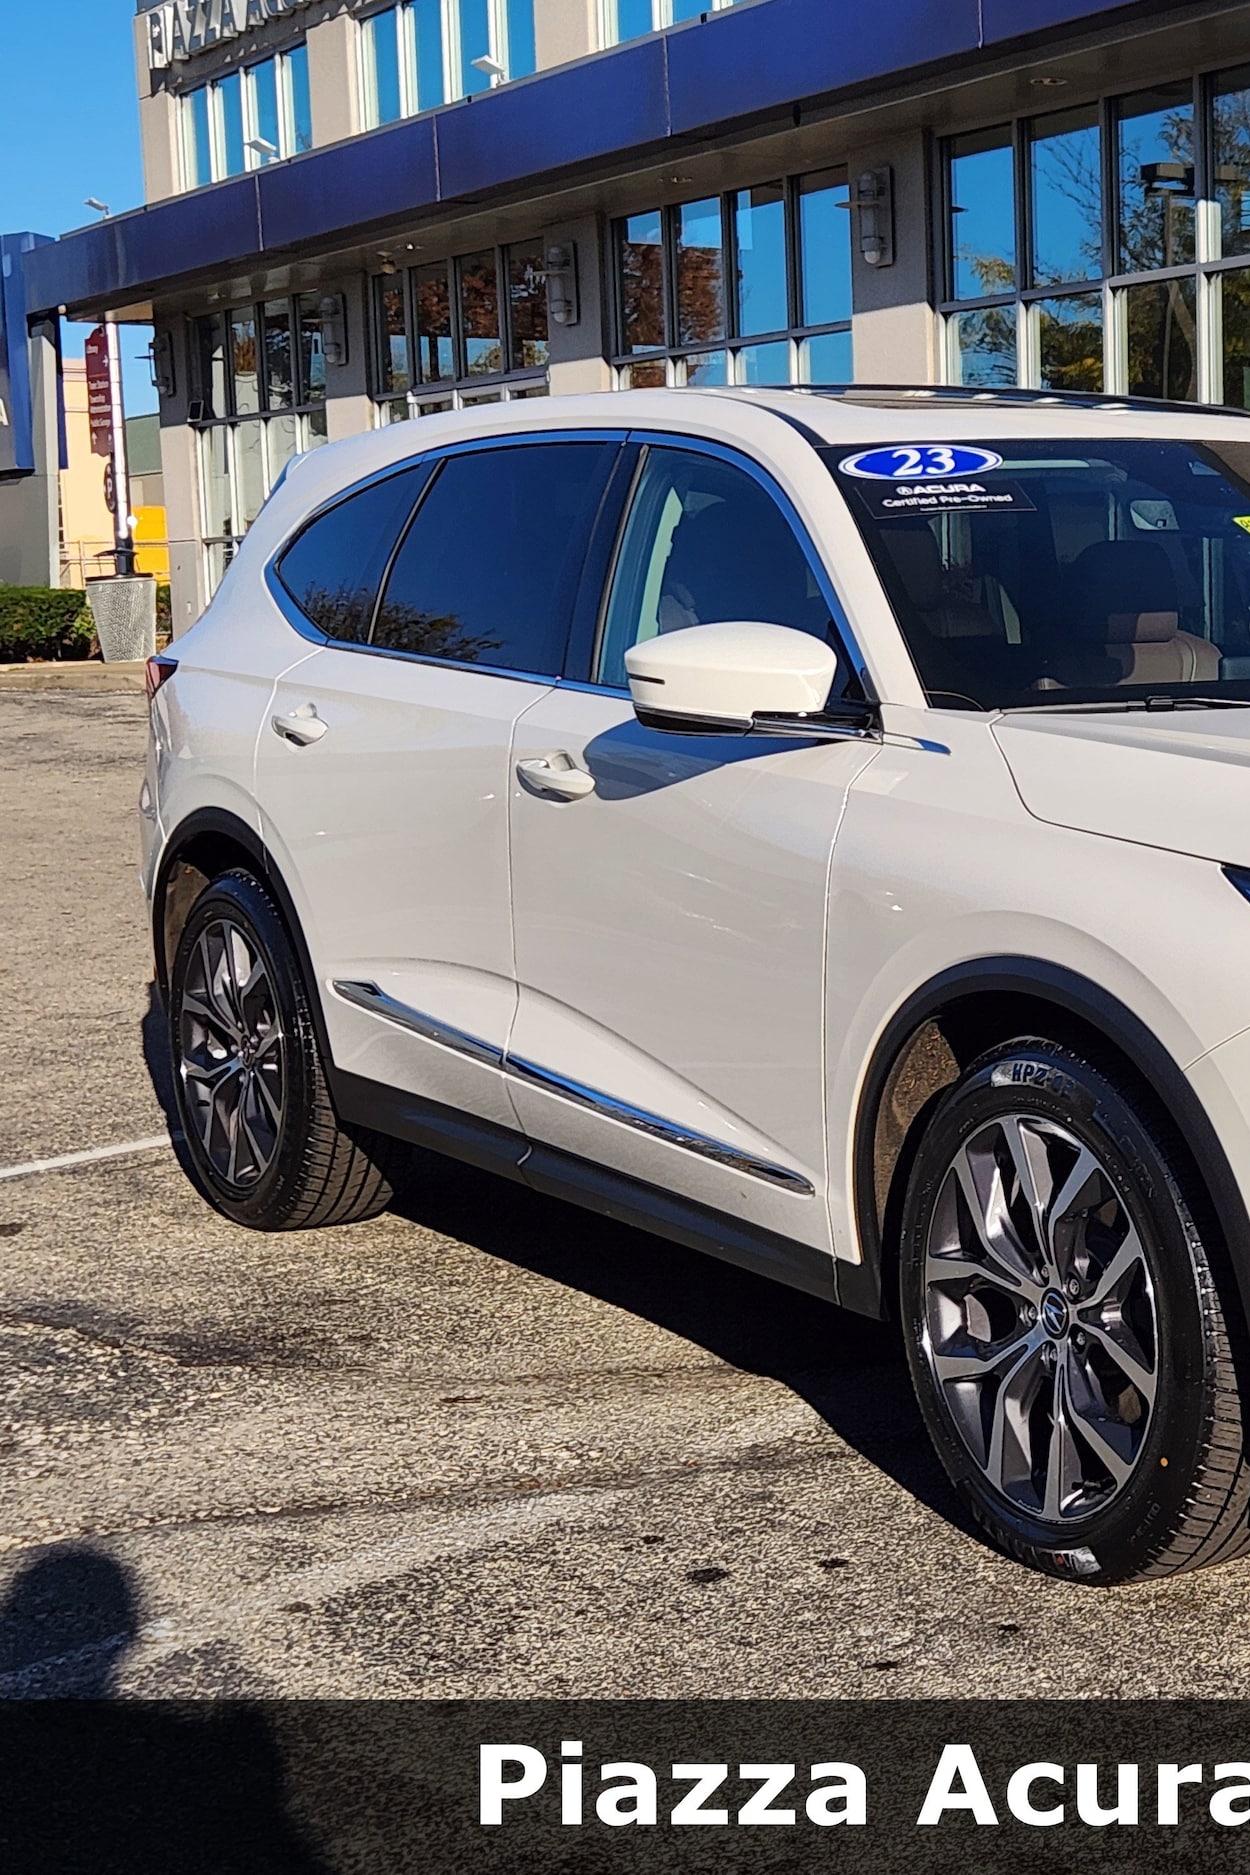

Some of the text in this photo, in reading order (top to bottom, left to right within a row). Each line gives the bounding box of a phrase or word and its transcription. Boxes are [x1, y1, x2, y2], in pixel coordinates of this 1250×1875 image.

[891, 448, 955, 477] 23
[913, 483, 986, 494] ACURA
[882, 494, 1013, 507] Certified Pre-Owned
